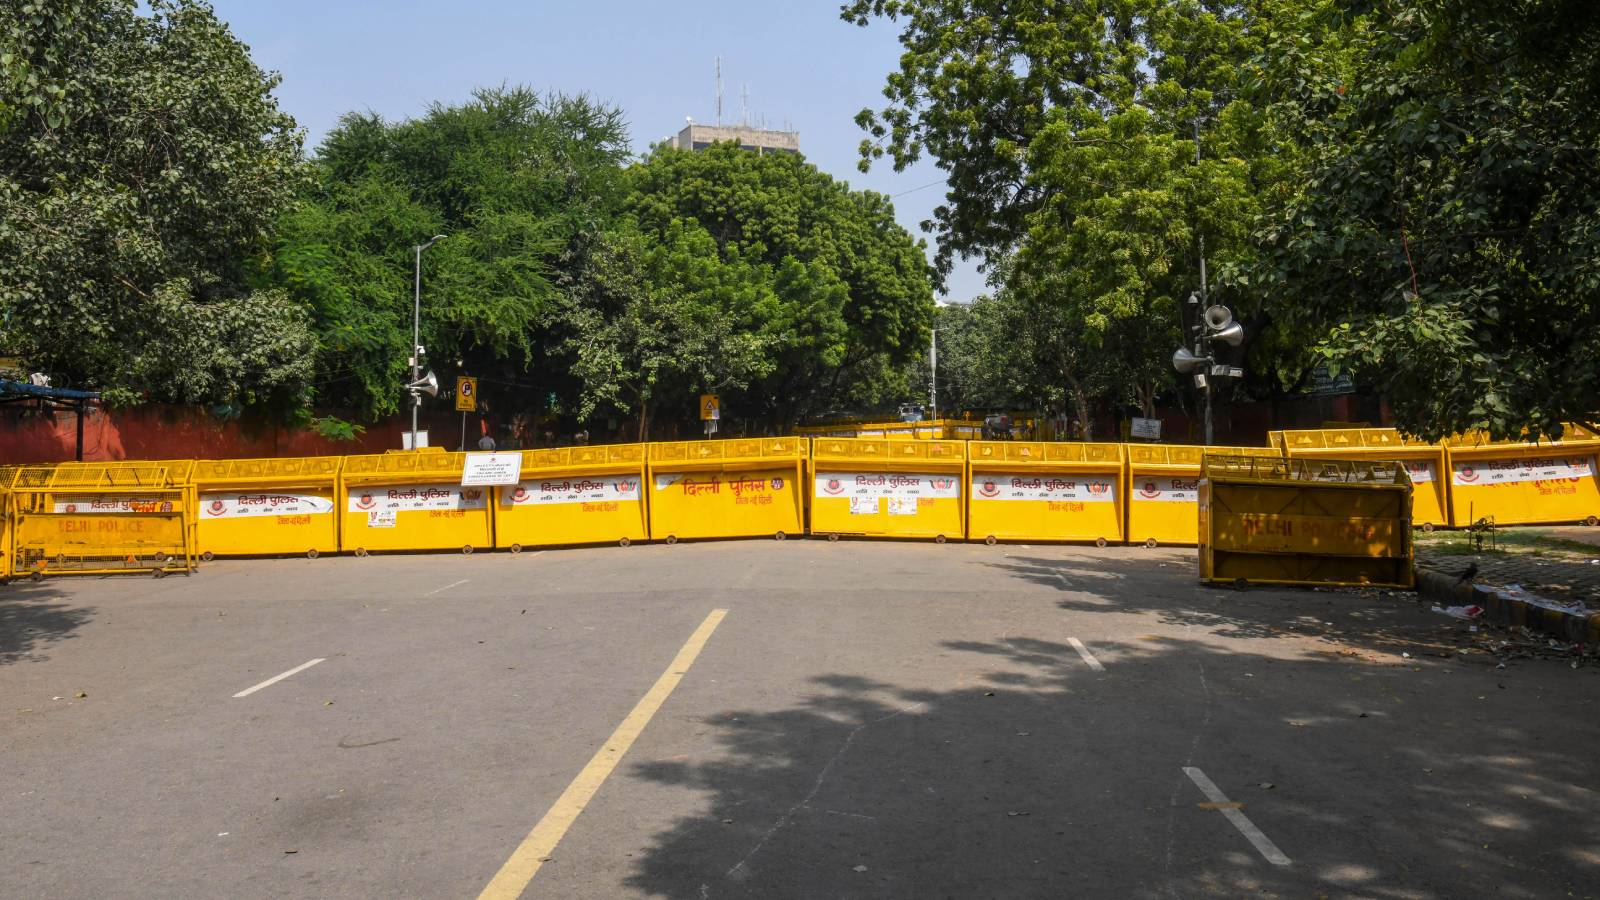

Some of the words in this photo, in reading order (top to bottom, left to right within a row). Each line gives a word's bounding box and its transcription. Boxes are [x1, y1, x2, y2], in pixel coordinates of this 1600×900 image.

[541, 481, 570, 492] दिल्ली
[573, 480, 603, 493] पुलिस
[682, 475, 721, 495] दिल्ली
[727, 475, 765, 496] पुलिस
[855, 475, 885, 486] दिल्ली
[889, 475, 920, 488] पुलिस
[1011, 478, 1041, 489] दिल्ली
[1044, 478, 1075, 491] पुलिस
[1171, 479, 1198, 489] दिल्ल
[238, 495, 266, 505] दिल्ली
[270, 495, 298, 506] पुलिस
[388, 489, 417, 499] दिल्ली
[420, 488, 449, 501] पुलिस
[99, 520, 144, 533] POLICE
[1243, 518, 1292, 537] DELHI
